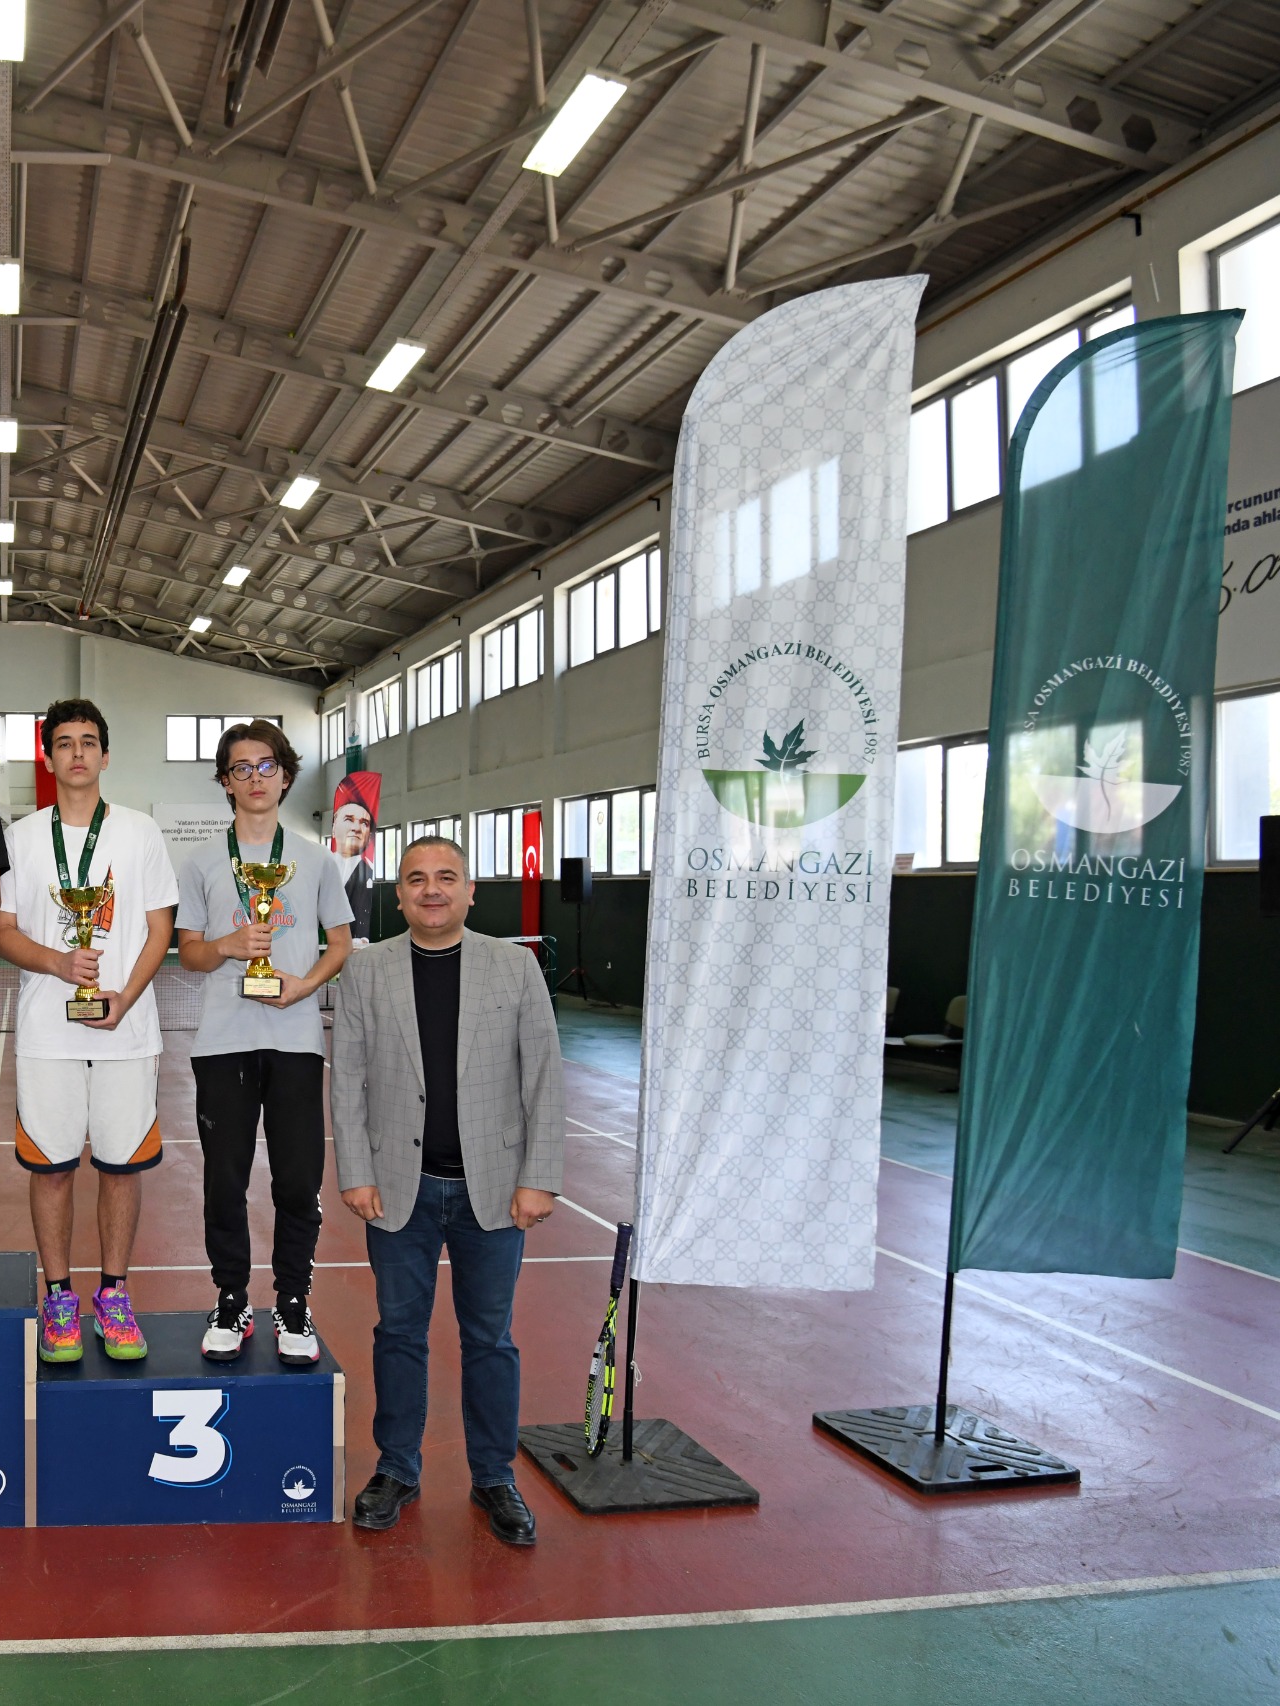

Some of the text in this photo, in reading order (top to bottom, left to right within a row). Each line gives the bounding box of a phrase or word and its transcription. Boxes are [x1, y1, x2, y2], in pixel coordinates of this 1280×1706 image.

[696, 640, 880, 765] BURSA OSMANGAZİ BELEDİYESİ 1987
[1033, 653, 1122, 706] OSMANGAZİ
[1126, 659, 1195, 738] BELEDİYESİ
[1177, 744, 1192, 777] 1987
[687, 847, 873, 876] OSMANGAZİ
[1010, 848, 1185, 882] OSMANGAZİ
[686, 878, 872, 903] BELEDİYESİ
[1008, 878, 1183, 909] BELEDİYESİ
[148, 1389, 232, 1487] 3
